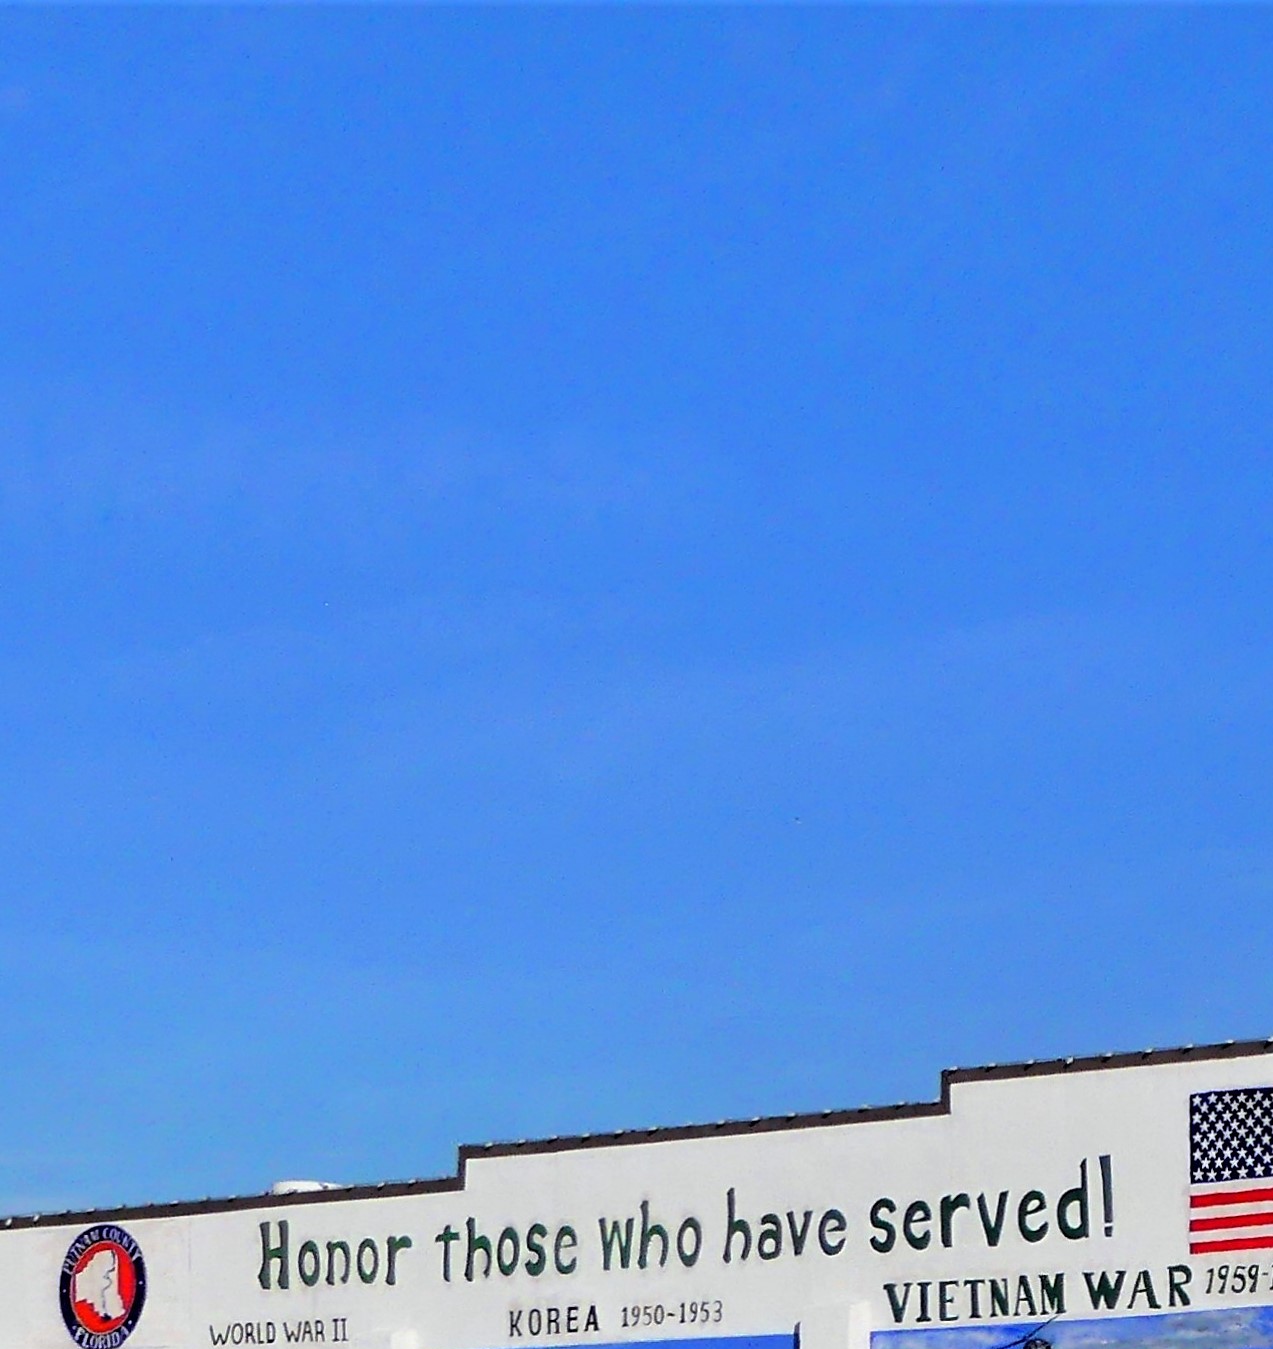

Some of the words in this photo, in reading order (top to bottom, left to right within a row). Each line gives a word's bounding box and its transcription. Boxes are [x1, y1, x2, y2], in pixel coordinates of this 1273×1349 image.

[257, 1219, 412, 1290] Honor
[435, 1216, 578, 1283] those
[598, 1199, 702, 1271] who
[722, 1186, 847, 1263] have
[869, 1154, 1114, 1254] served!
[63, 1229, 101, 1275] PUTNAM
[102, 1227, 142, 1262] COUNTY
[882, 1273, 1067, 1324] VIETNAM
[1081, 1263, 1194, 1311] WAR
[73, 1325, 130, 1349] FLORIDA
[209, 1321, 276, 1346] WORLD
[282, 1318, 325, 1343] WAR
[332, 1317, 349, 1342] II
[509, 1304, 601, 1337] KOREA
